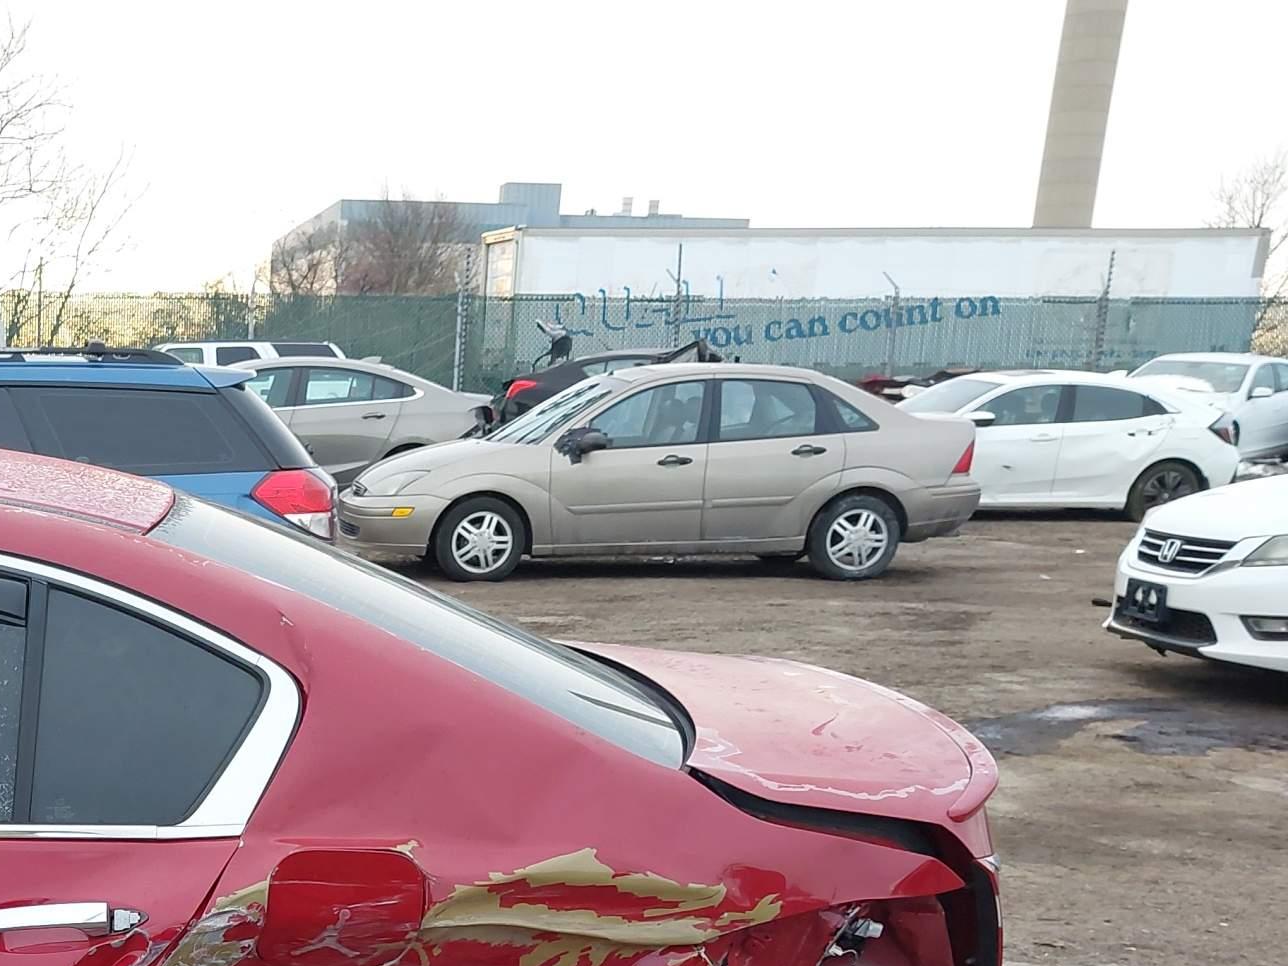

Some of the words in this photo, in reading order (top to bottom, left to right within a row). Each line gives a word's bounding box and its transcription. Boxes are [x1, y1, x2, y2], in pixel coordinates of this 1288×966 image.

[765, 314, 830, 342] can
[838, 297, 943, 334] count
[954, 295, 1002, 320] on
